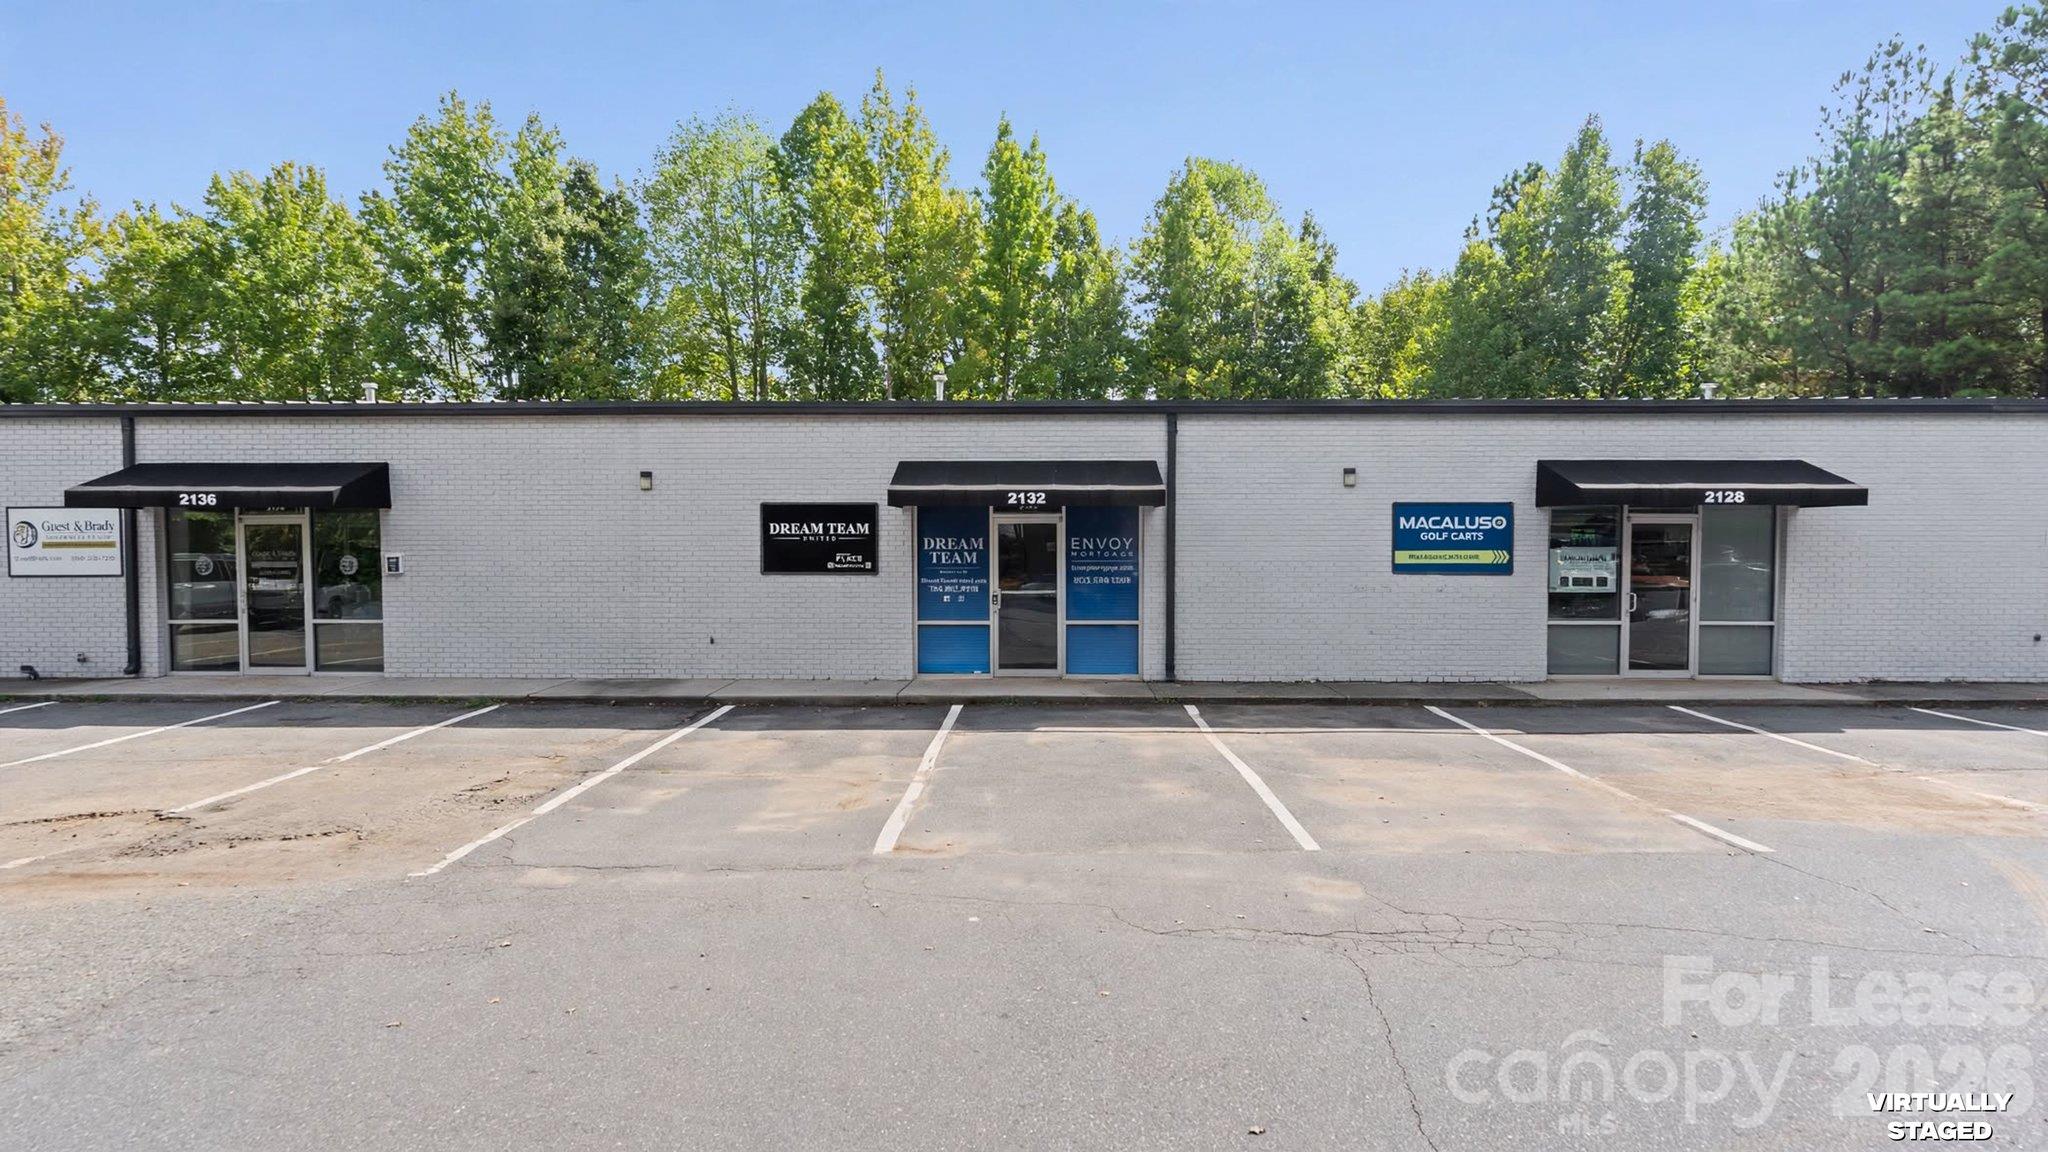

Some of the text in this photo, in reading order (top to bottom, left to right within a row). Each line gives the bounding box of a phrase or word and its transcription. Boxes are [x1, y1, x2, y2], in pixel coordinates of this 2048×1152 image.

[179, 493, 217, 506] 2136
[1007, 492, 1046, 505] 2132
[1704, 490, 1745, 504] 2128
[41, 520, 115, 533] Guest & Brady
[768, 522, 870, 535] DREAM TEAM
[1399, 516, 1507, 530] MACALUSO
[1420, 532, 1484, 541] GOLF CARTS
[923, 537, 984, 550] DREAM
[1071, 537, 1133, 550] ENVOY
[929, 551, 977, 564] TEAM
